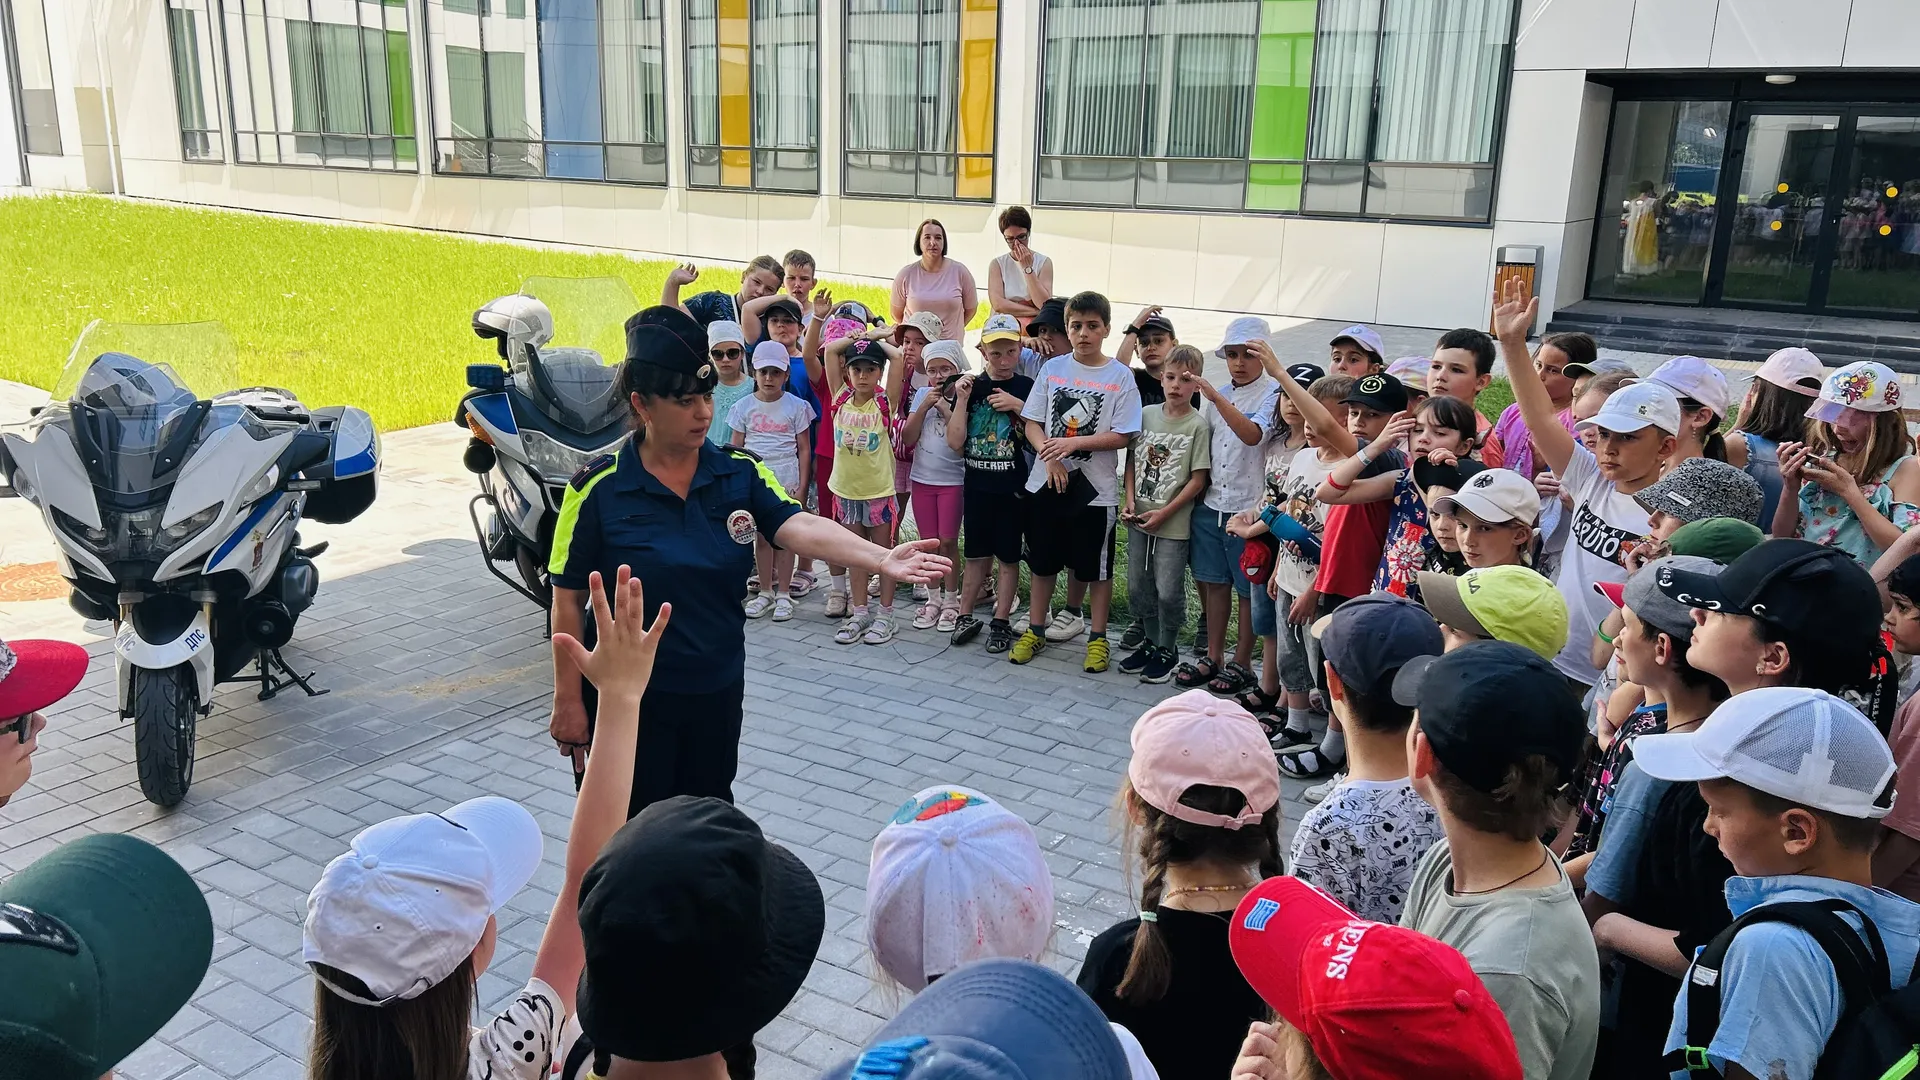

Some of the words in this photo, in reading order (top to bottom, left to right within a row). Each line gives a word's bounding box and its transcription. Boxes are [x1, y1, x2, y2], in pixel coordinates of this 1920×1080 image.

[1294, 366, 1313, 382] Z
[1137, 428, 1194, 450] CREATE
[184, 629, 205, 652] ДПС
